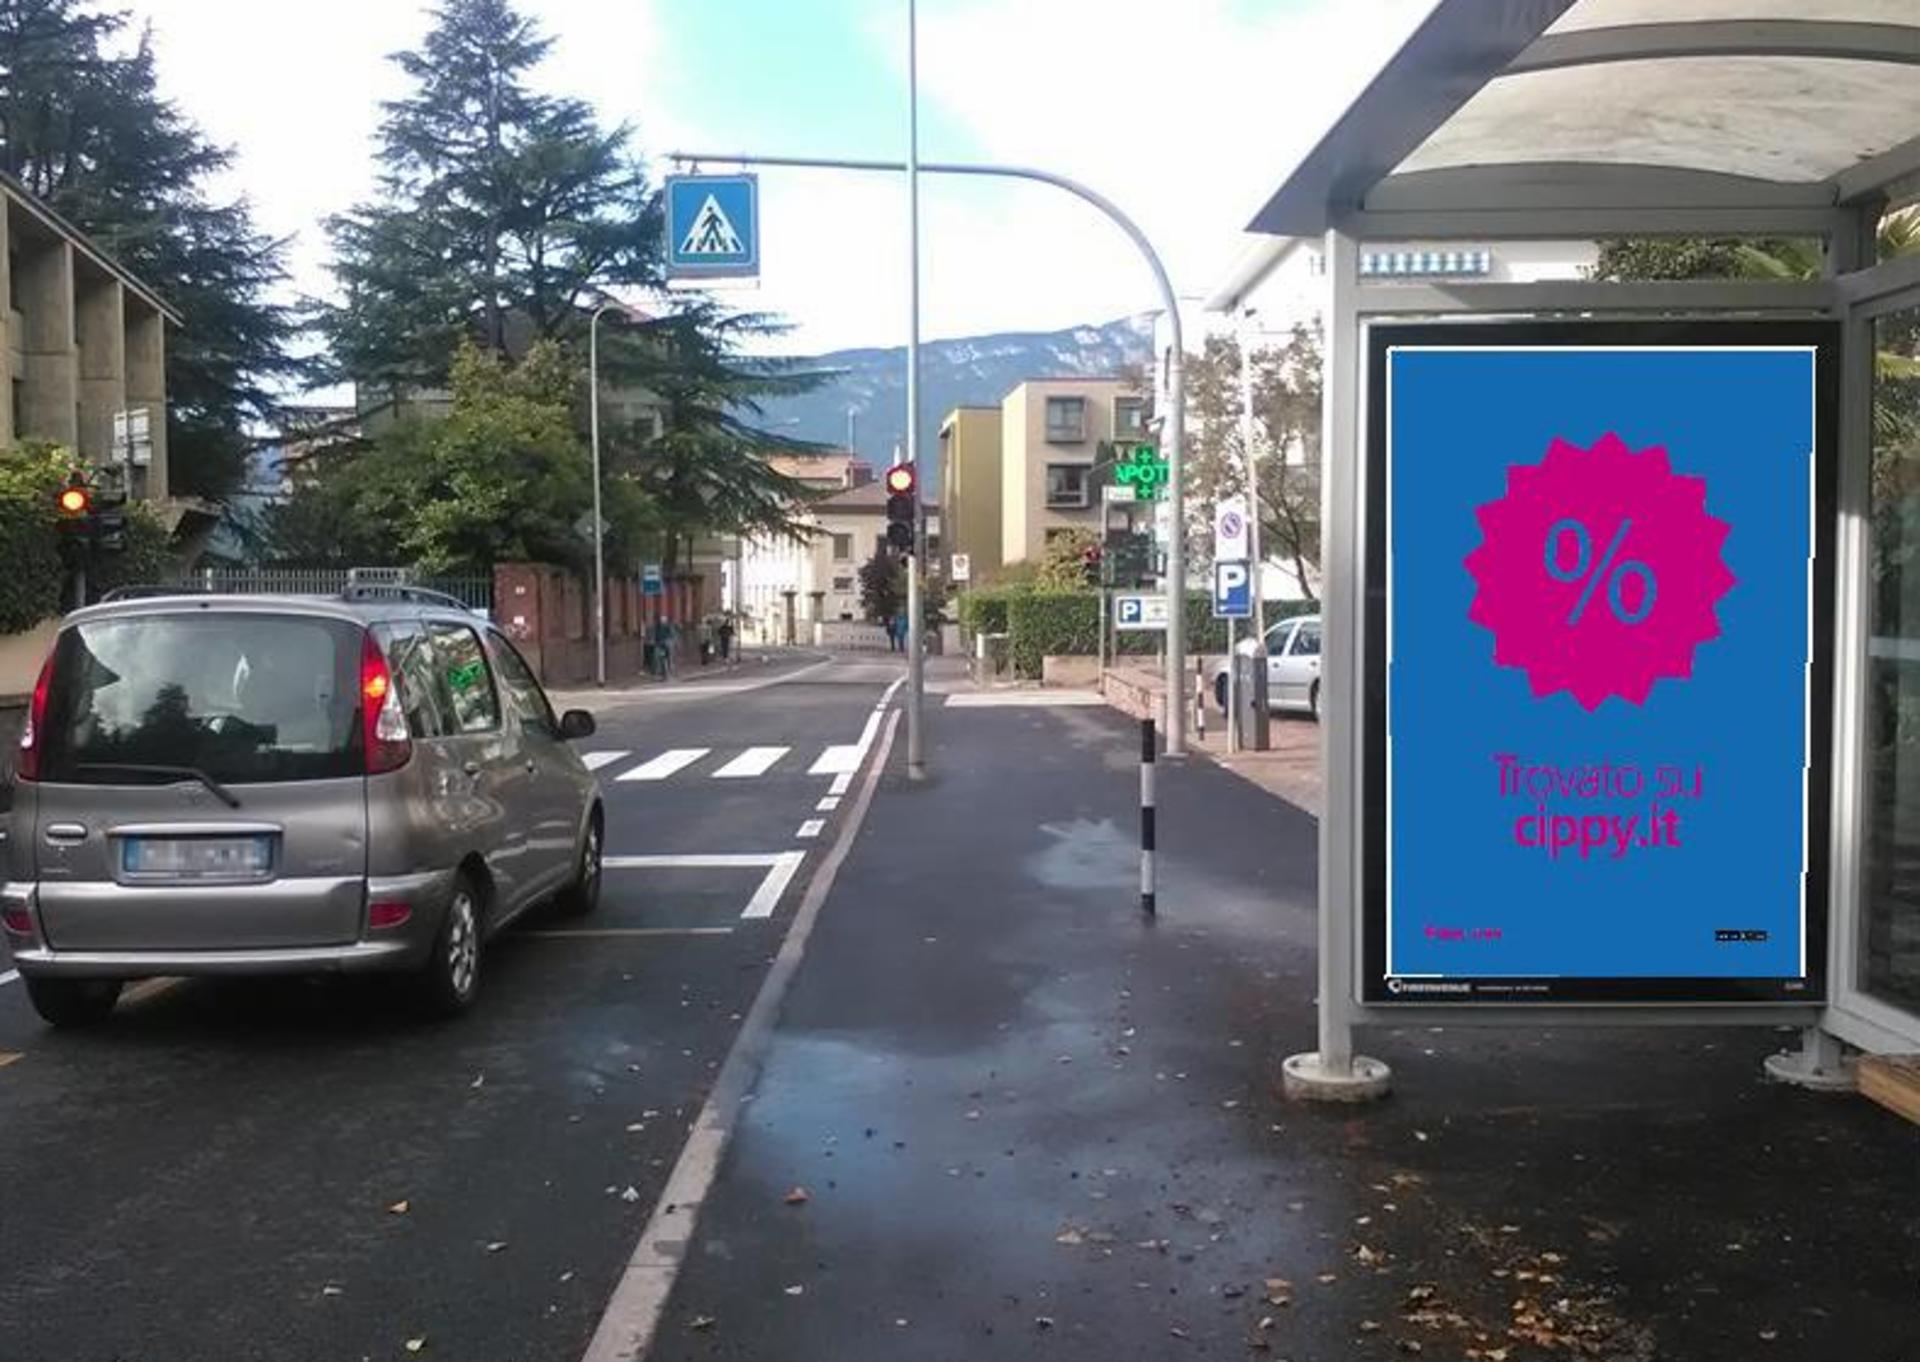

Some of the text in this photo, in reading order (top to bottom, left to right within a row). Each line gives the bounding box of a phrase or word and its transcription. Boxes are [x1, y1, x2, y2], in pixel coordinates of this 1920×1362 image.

[1219, 564, 1247, 600] P
[1544, 518, 1657, 625] %
[1122, 601, 1138, 620] P
[1494, 753, 1704, 798] Trovato su
[1514, 803, 1683, 861] cippy.it
